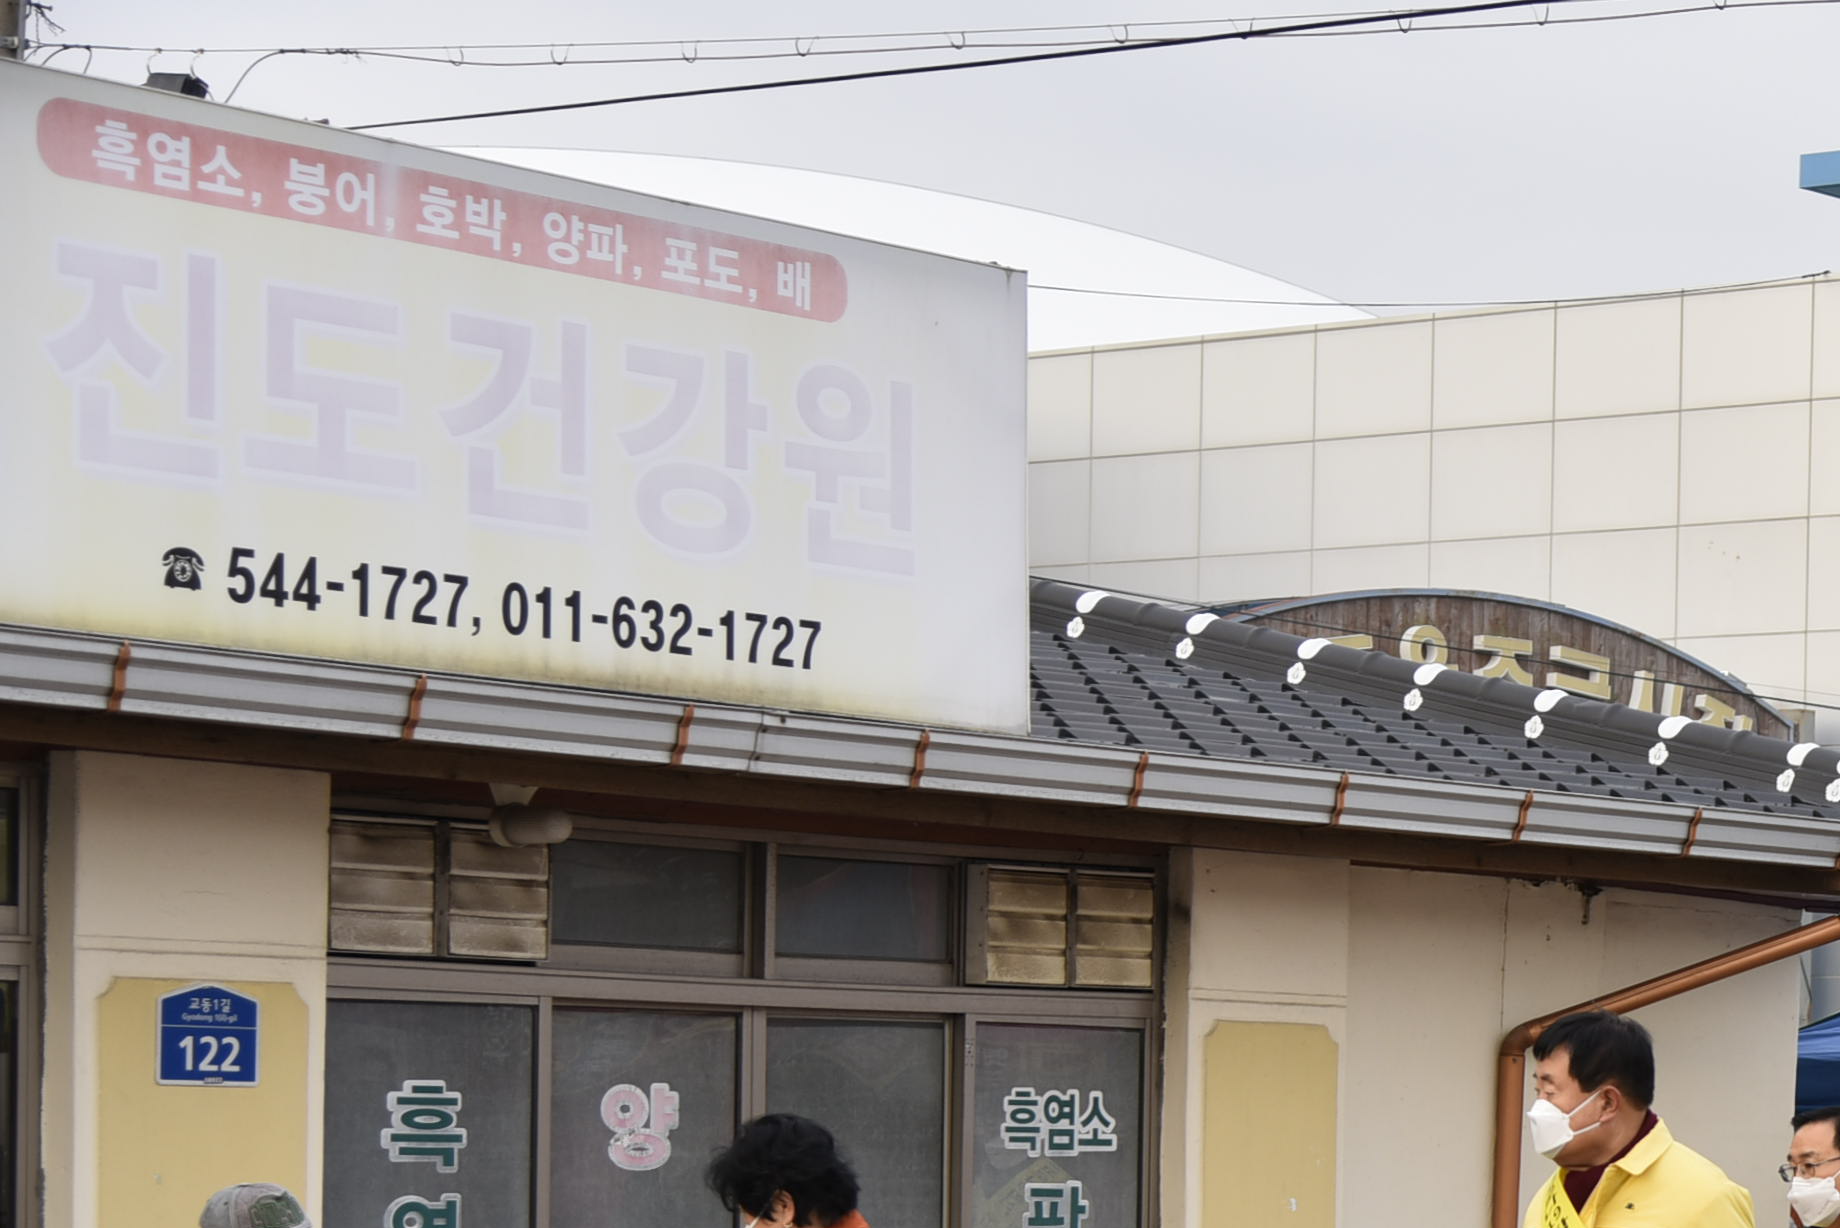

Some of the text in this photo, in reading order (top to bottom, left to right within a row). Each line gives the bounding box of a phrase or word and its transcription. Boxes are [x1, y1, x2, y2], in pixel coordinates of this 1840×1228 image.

[90, 119, 812, 313] 흑염소, 붕어, 호박, 양파, 포도, 배
[45, 237, 918, 580] 진도건강원
[226, 545, 823, 671] 544-1727, 011-632-1727
[178, 1035, 241, 1073] 122
[188, 997, 232, 1014] 교동1길
[1001, 1086, 1117, 1158] 흑염소
